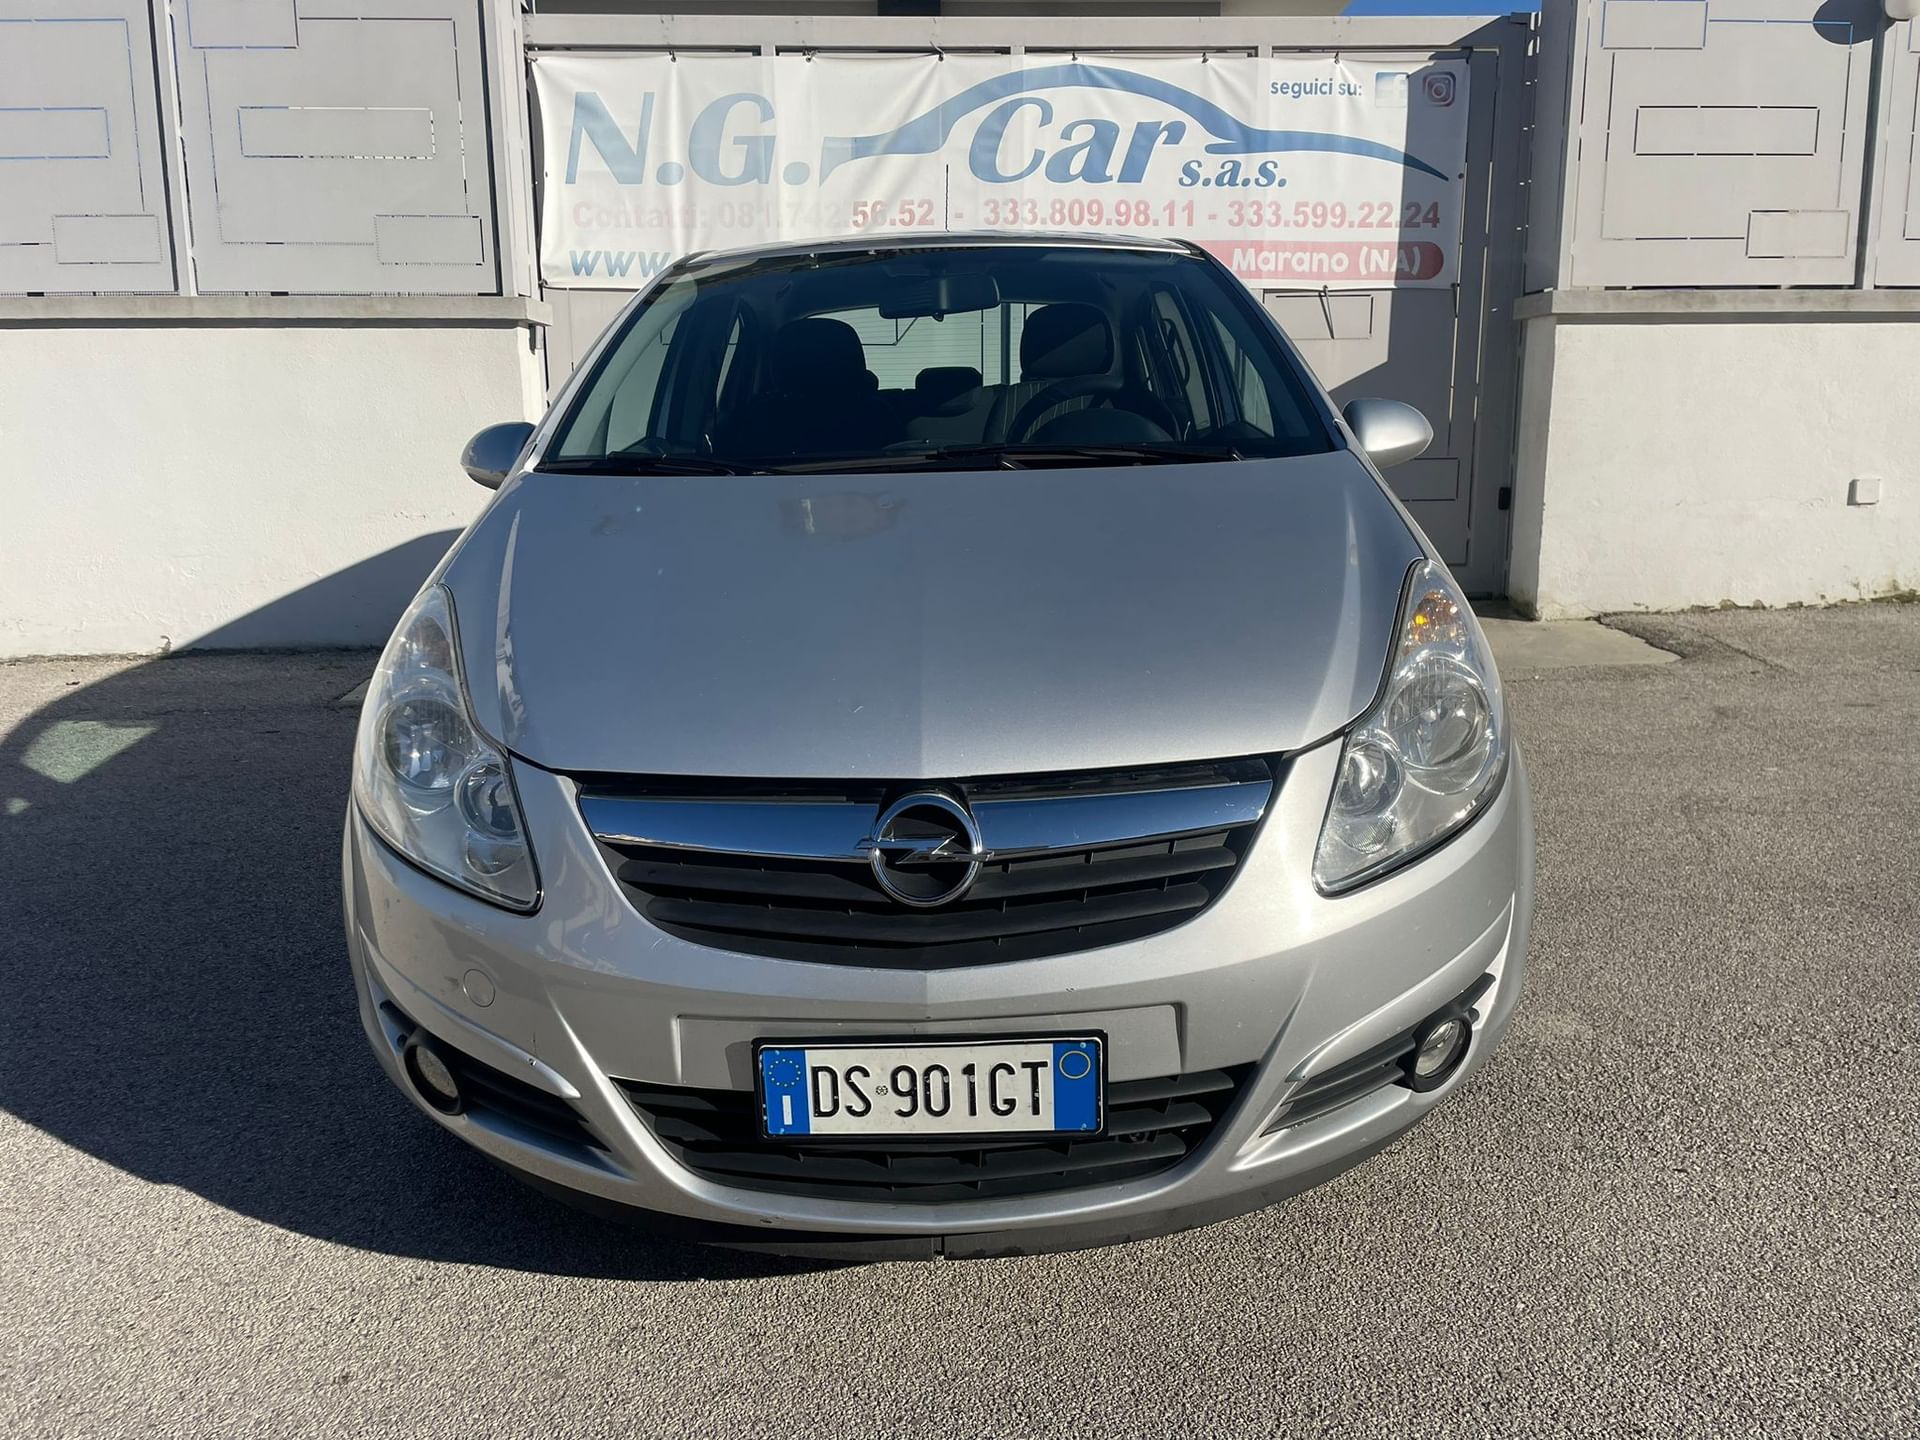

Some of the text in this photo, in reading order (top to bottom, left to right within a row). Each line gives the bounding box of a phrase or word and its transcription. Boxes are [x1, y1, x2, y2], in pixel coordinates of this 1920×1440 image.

[1269, 77, 1363, 99] seguici su:
[564, 91, 1288, 189] N.G. Car s.a.s.
[573, 199, 707, 230] Contatti:
[718, 198, 935, 230] 081.742.56.52
[983, 197, 1196, 228] 333.809.98.11
[1227, 199, 1441, 230] 333.599.22.24
[1232, 246, 1422, 278] Marano (NA)
